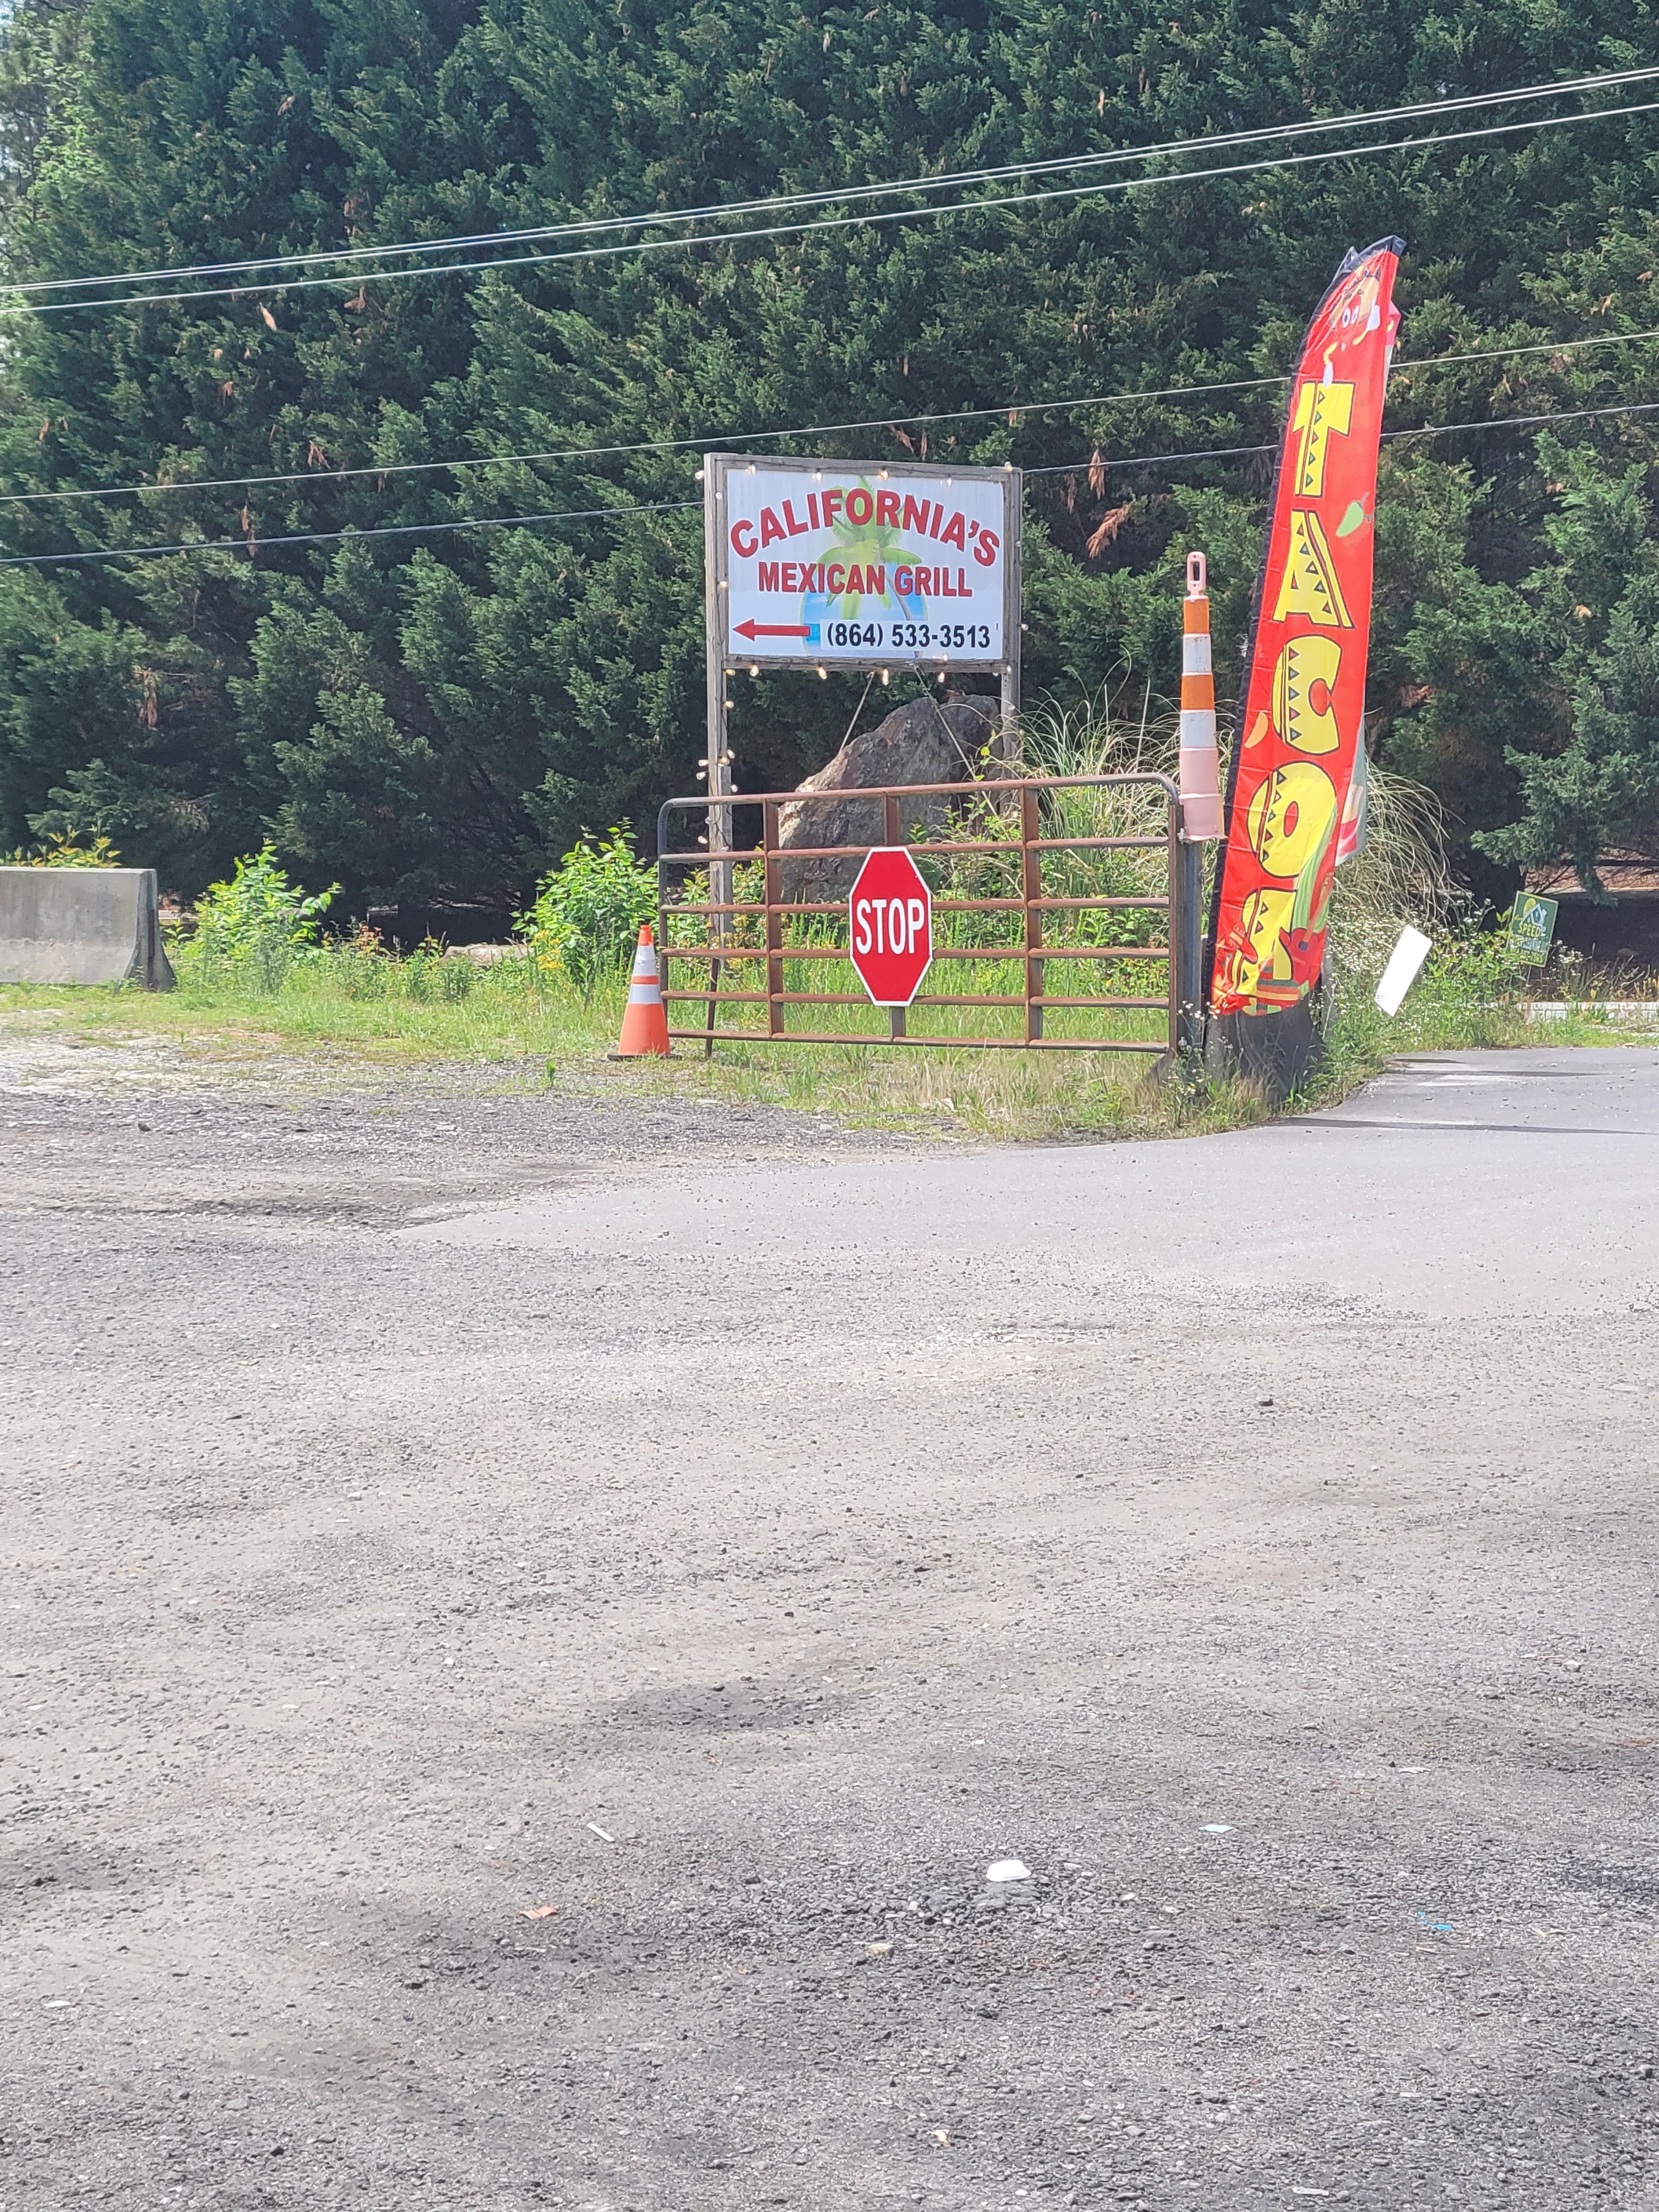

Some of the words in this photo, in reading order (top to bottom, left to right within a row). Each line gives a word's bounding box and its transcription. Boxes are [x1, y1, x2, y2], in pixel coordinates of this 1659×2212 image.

[730, 488, 1000, 567] CALIFORNIA'S
[758, 562, 885, 595] MEXICAN
[894, 566, 973, 597] GRILL
[827, 623, 883, 648] (864)
[891, 624, 990, 648] 533-3513
[1231, 381, 1354, 997] TACOS
[856, 898, 925, 955] STOP
